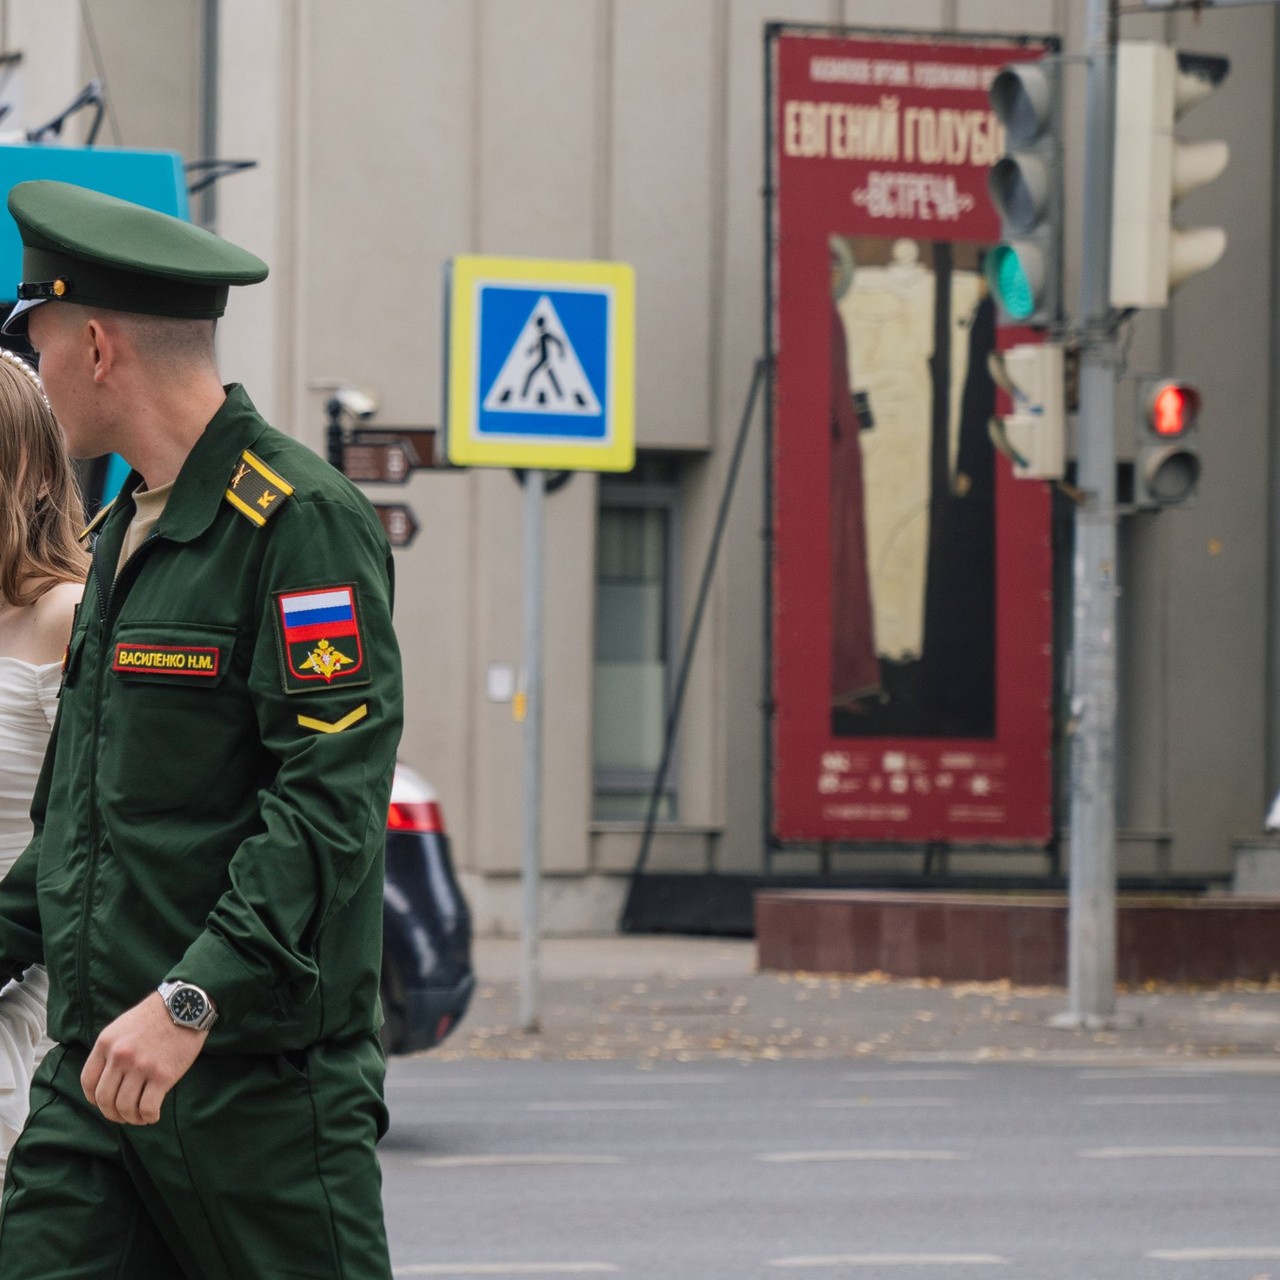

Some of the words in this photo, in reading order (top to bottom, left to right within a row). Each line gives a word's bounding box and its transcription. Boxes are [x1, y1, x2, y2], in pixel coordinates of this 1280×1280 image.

[784, 94, 900, 162] ЕВГЕНИЙ
[118, 651, 186, 668] ВАСИЛЕНКО
[187, 655, 214, 669] Н.М.
